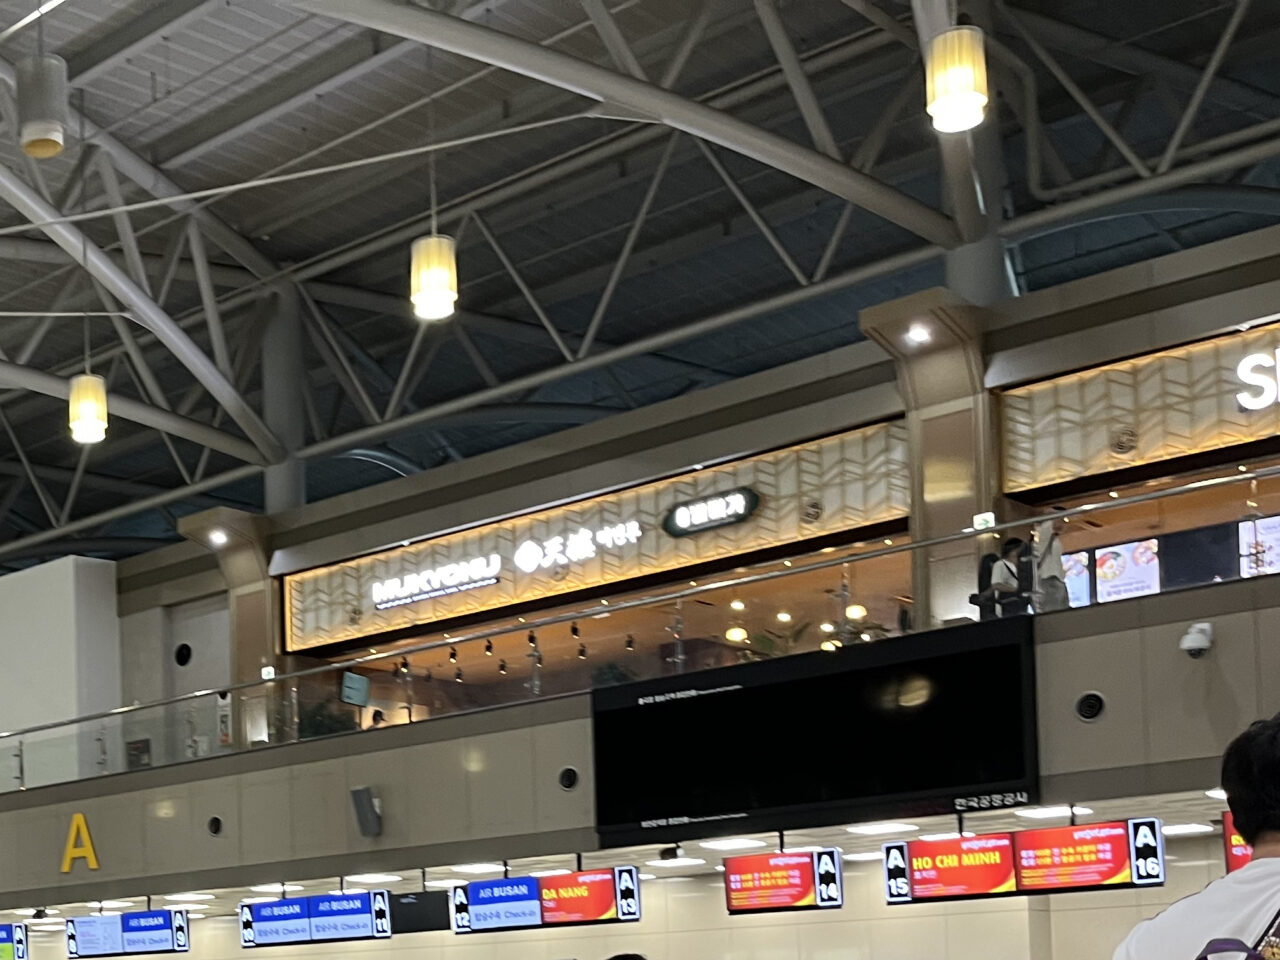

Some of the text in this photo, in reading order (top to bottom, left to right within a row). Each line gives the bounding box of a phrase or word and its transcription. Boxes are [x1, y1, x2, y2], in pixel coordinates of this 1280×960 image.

[61, 813, 100, 873] A
[819, 855, 835, 874] A
[1135, 826, 1160, 876] A 16
[620, 872, 634, 890] A
[888, 849, 909, 895] A 15
